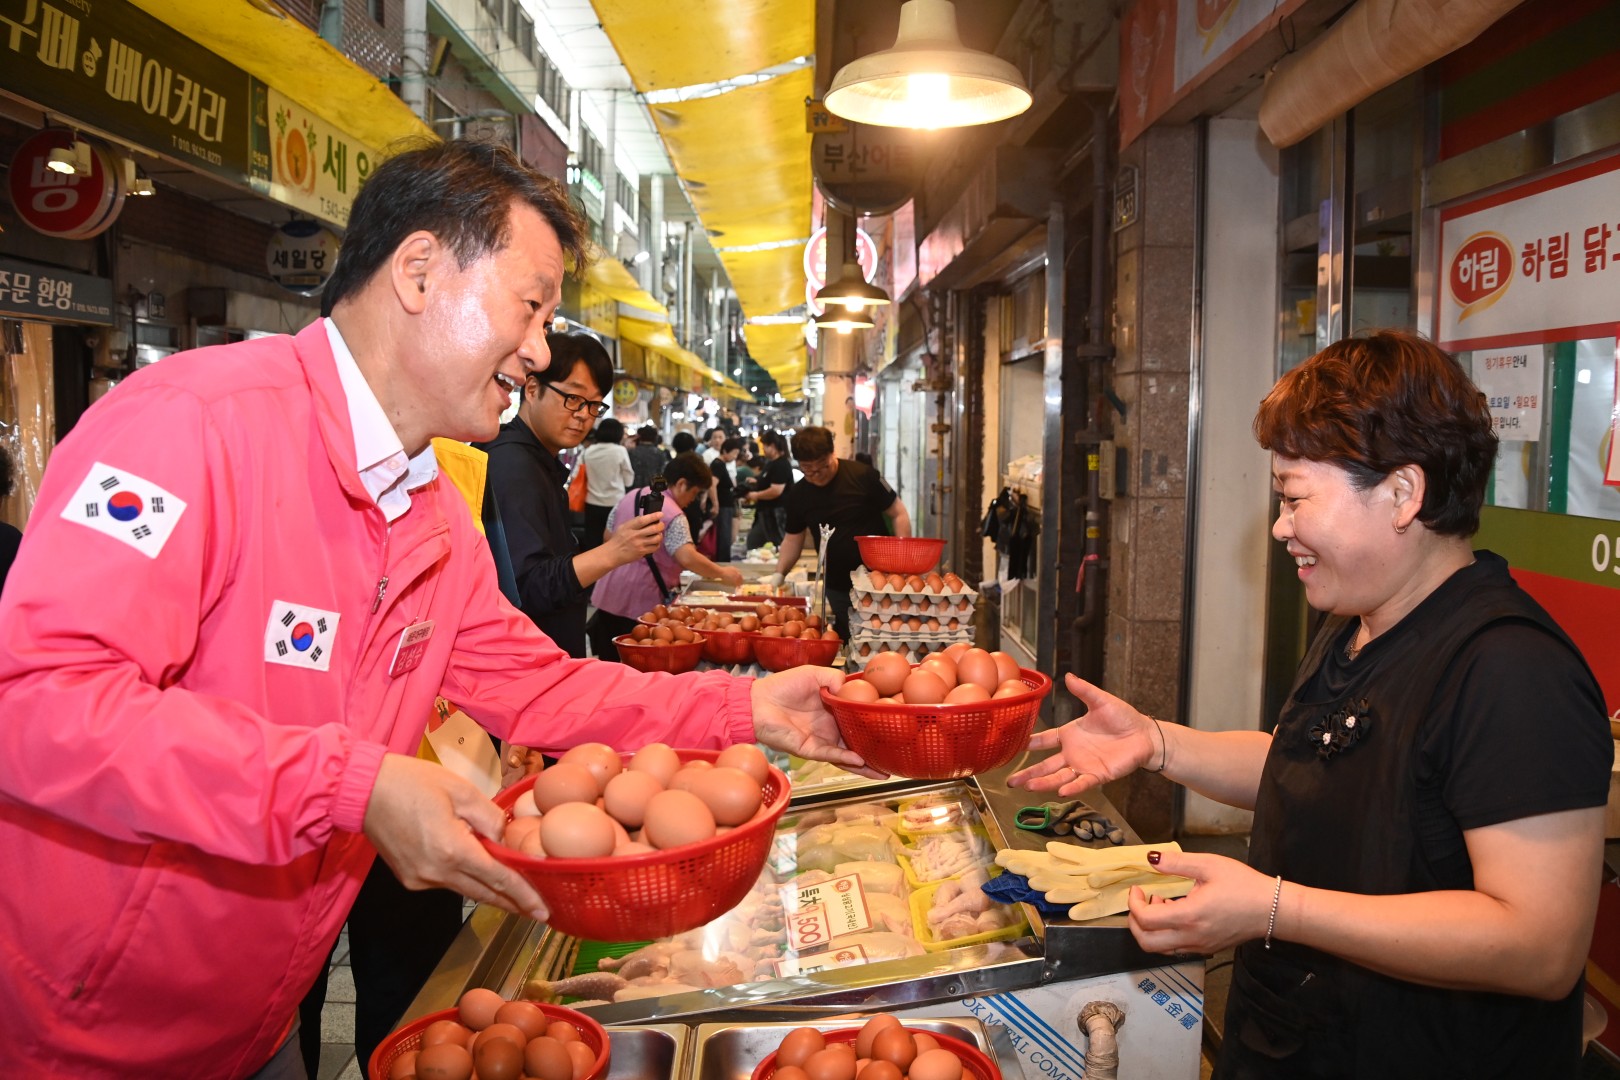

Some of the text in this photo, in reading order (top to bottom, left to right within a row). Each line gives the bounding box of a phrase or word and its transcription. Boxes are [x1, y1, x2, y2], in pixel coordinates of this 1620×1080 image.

[105, 37, 227, 143] 베이커리
[272, 249, 327, 271] 세일당
[1458, 247, 1499, 291] 하림
[1521, 222, 1620, 283] 하림 닭
[37, 276, 73, 310] 환영
[981, 1012, 1031, 1056] MTAL
